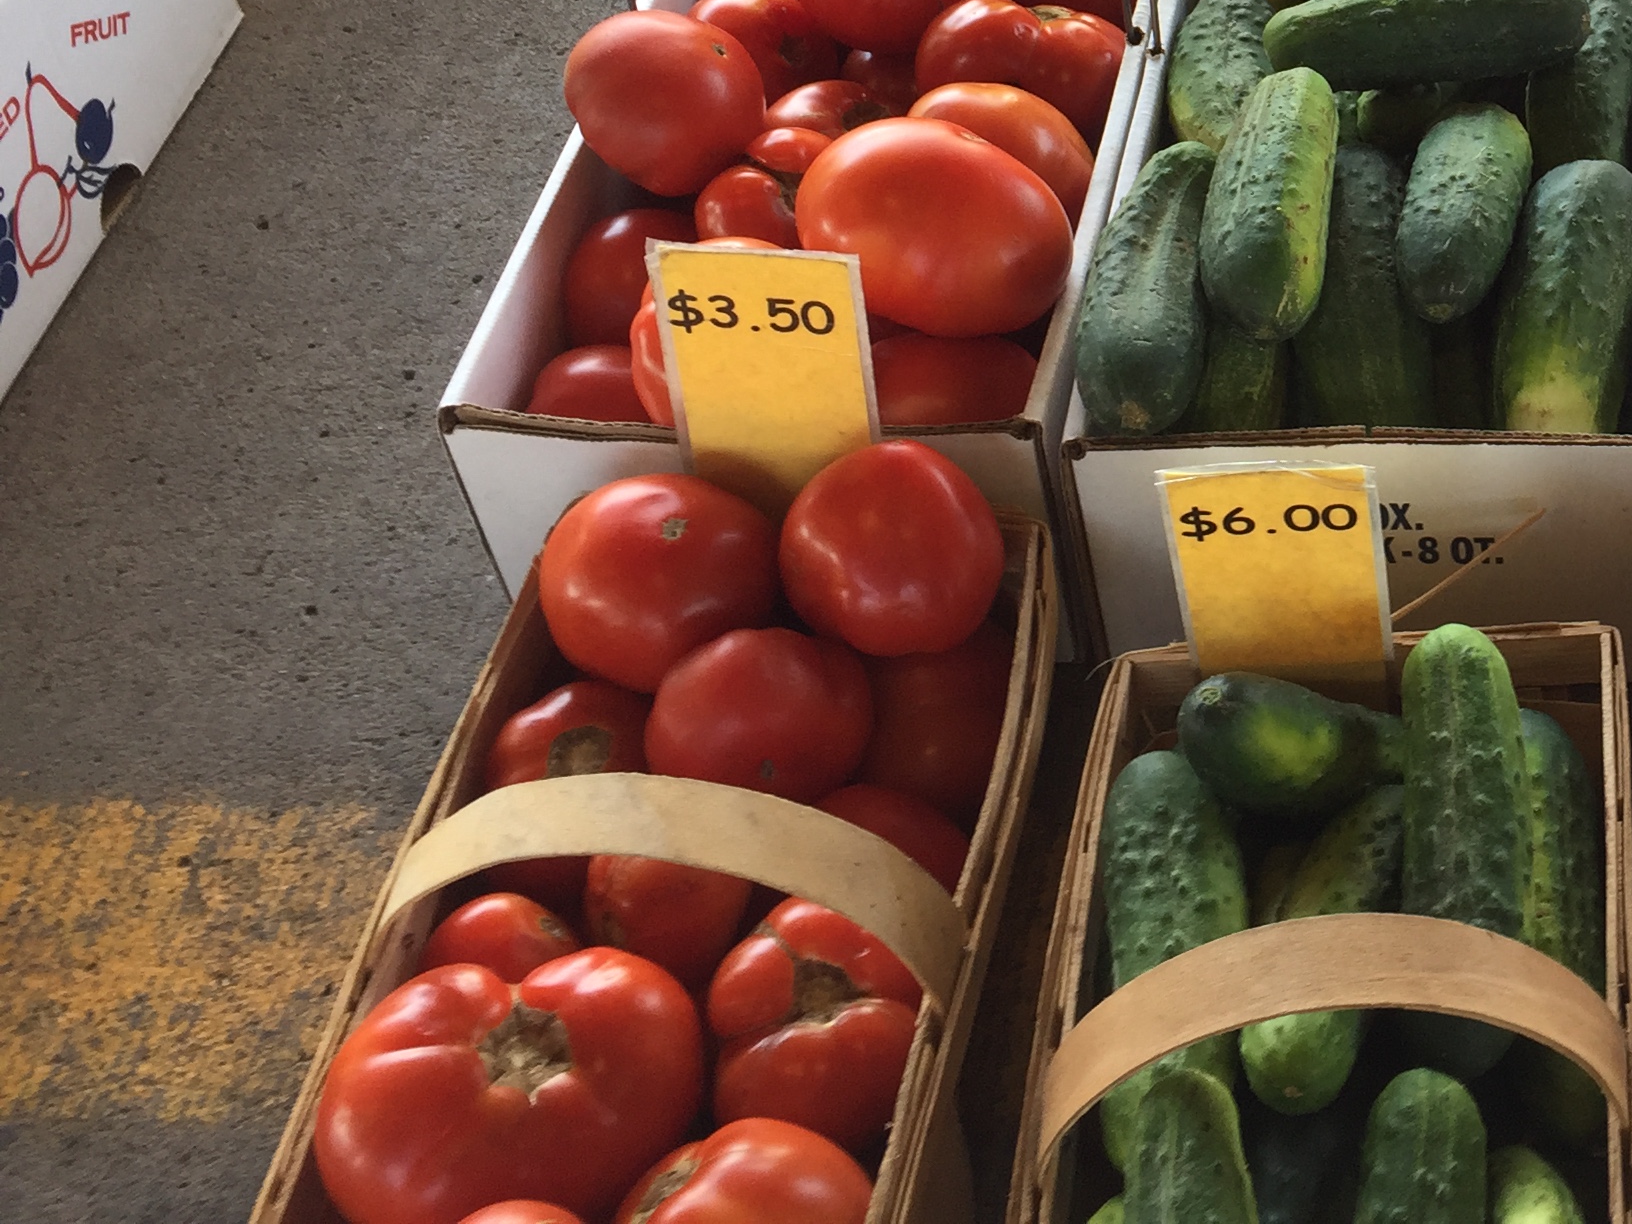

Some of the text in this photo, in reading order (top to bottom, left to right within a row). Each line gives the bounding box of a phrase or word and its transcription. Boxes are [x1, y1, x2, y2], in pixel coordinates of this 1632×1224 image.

[70, 11, 131, 48] FRUIT
[667, 289, 836, 335] $3.50
[1179, 504, 1358, 542] $6.00
